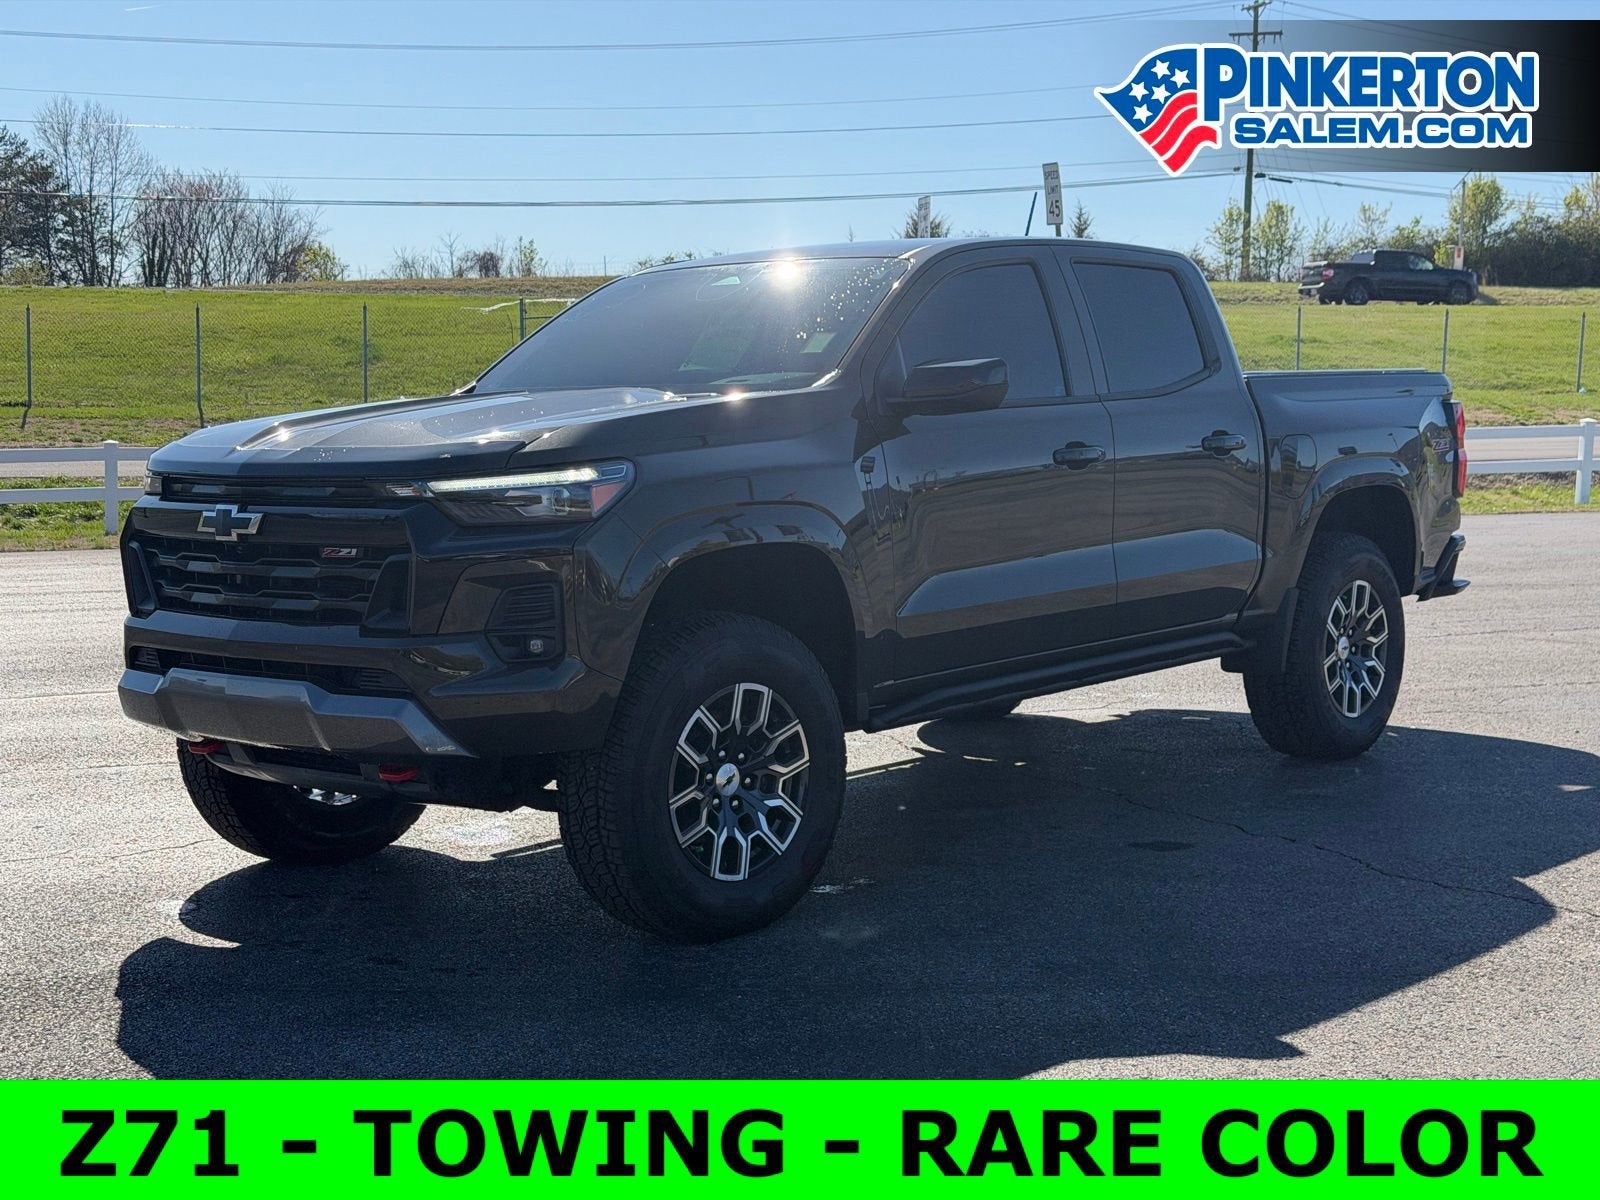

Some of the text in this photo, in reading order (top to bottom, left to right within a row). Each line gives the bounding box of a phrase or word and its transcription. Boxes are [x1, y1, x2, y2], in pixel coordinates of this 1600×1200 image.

[1045, 169, 1059, 179] SPEED
[1048, 199, 1061, 217] 45
[321, 547, 358, 558] Z71
